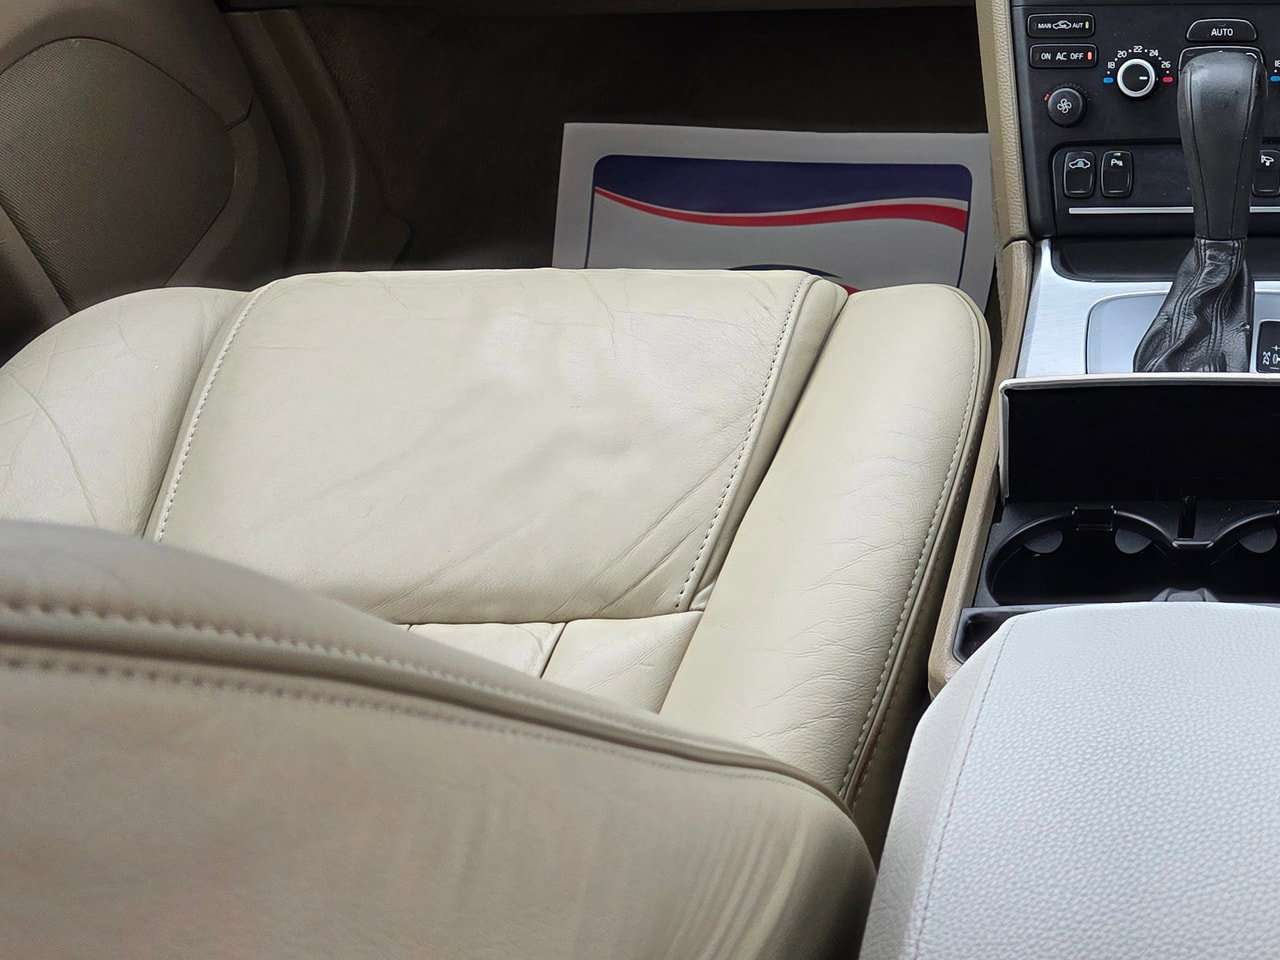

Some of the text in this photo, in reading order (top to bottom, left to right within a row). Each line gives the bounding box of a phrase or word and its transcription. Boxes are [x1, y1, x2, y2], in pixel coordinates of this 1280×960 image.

[1210, 28, 1234, 37] AUTO
[1040, 52, 1084, 61] ON AC OFF
[1107, 45, 1171, 69] 18 20 22 24 26
